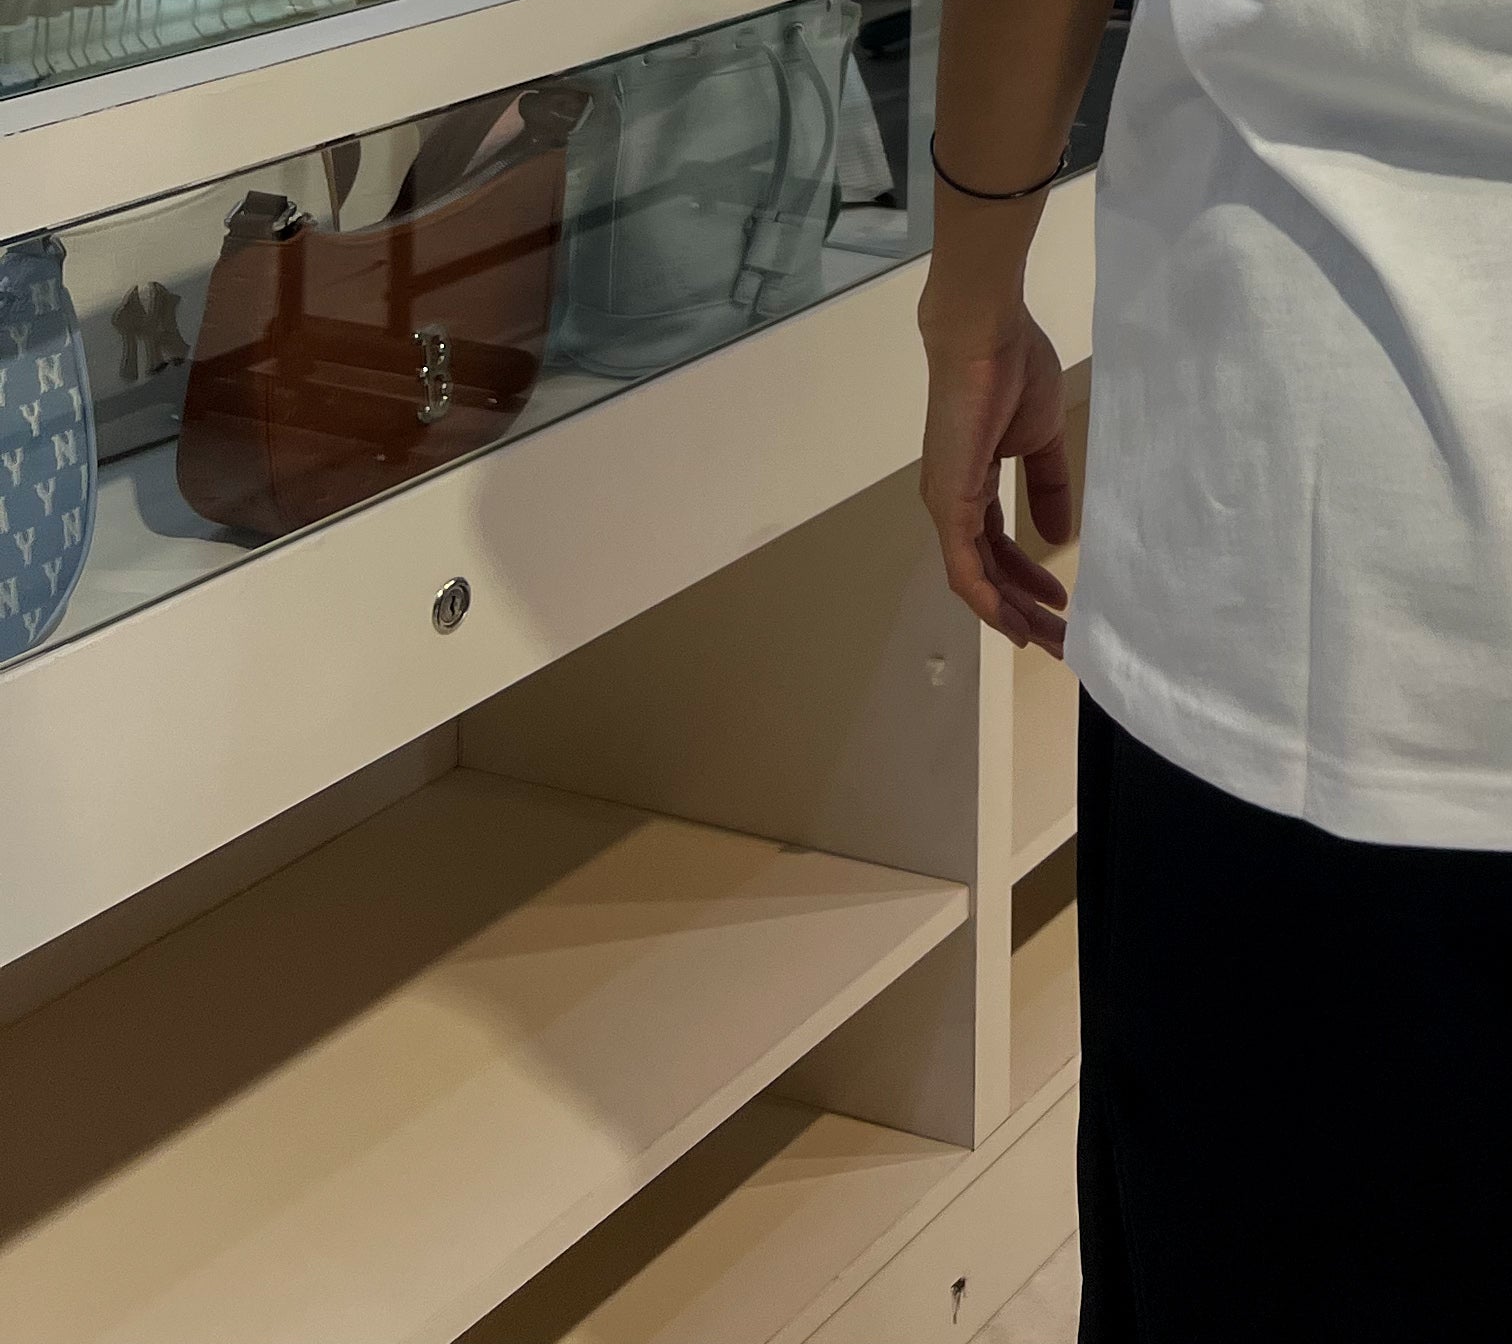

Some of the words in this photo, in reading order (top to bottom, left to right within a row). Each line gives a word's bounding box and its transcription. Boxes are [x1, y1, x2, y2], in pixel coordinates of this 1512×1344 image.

[35, 353, 64, 394] N
[19, 398, 41, 437] Y
[2, 447, 24, 487] Y
[51, 429, 78, 470] N
[34, 477, 57, 517] Y
[14, 526, 36, 567] Y
[62, 507, 82, 550] N
